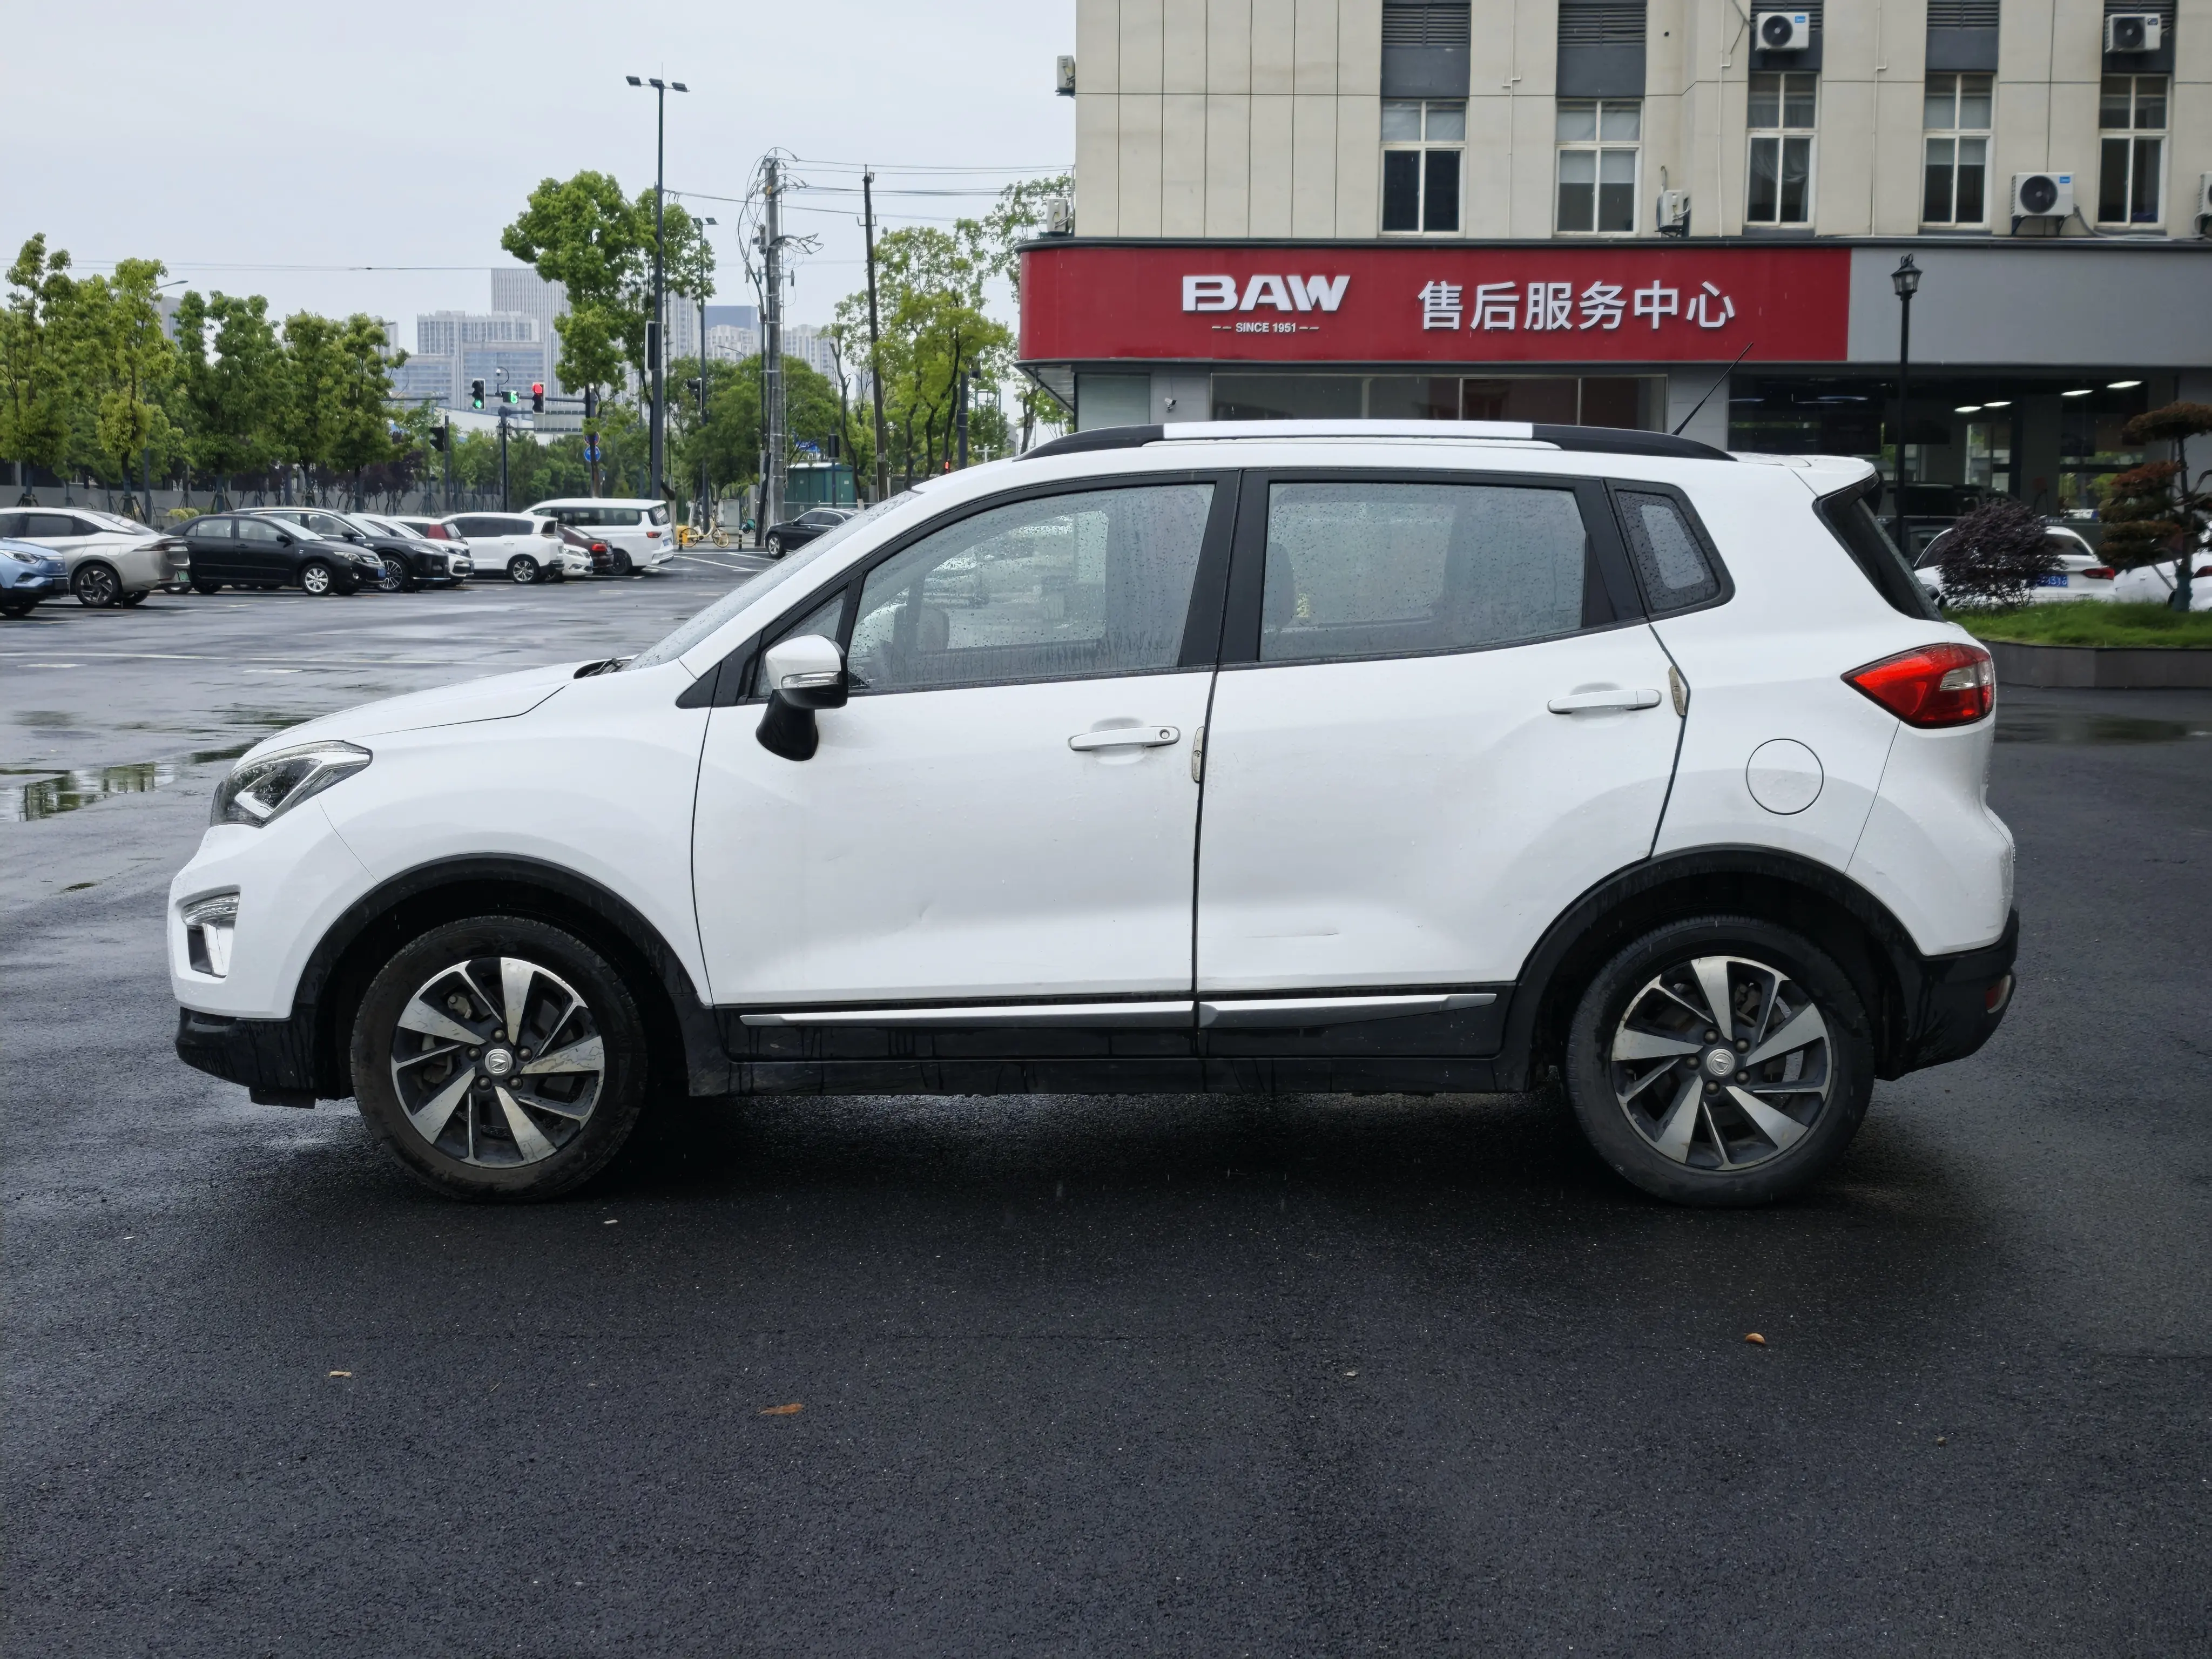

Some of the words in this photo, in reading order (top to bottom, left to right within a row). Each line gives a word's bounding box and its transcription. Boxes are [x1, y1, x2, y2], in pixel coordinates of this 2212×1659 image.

[1183, 275, 1351, 311] BAW
[1418, 280, 1735, 330] 售后服务中心
[1236, 322, 1269, 332] SINCE
[1272, 322, 1296, 332] 1951
